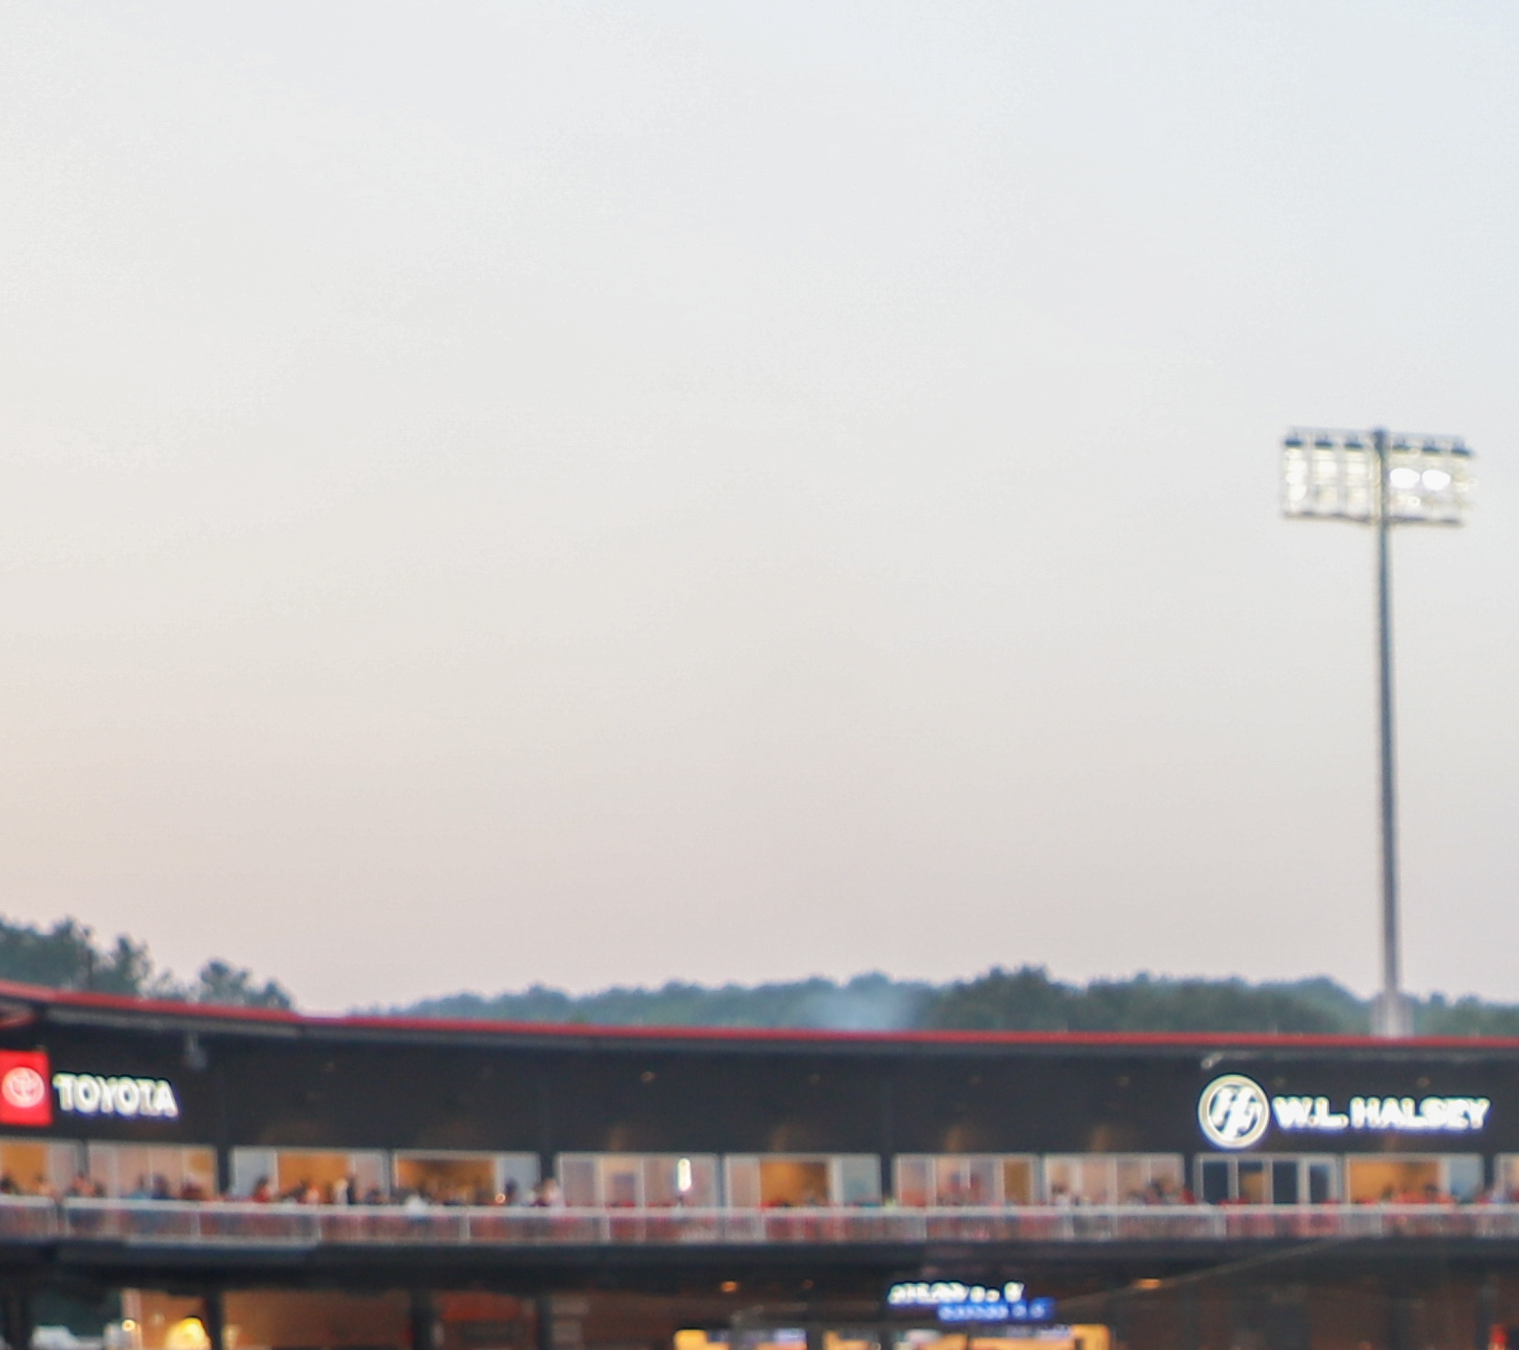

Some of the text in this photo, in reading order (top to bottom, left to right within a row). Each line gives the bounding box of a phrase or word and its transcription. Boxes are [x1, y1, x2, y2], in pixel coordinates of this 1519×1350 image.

[52, 1073, 179, 1117] TOYOTA
[1272, 1096, 1490, 1129] W.L. HALSEY
